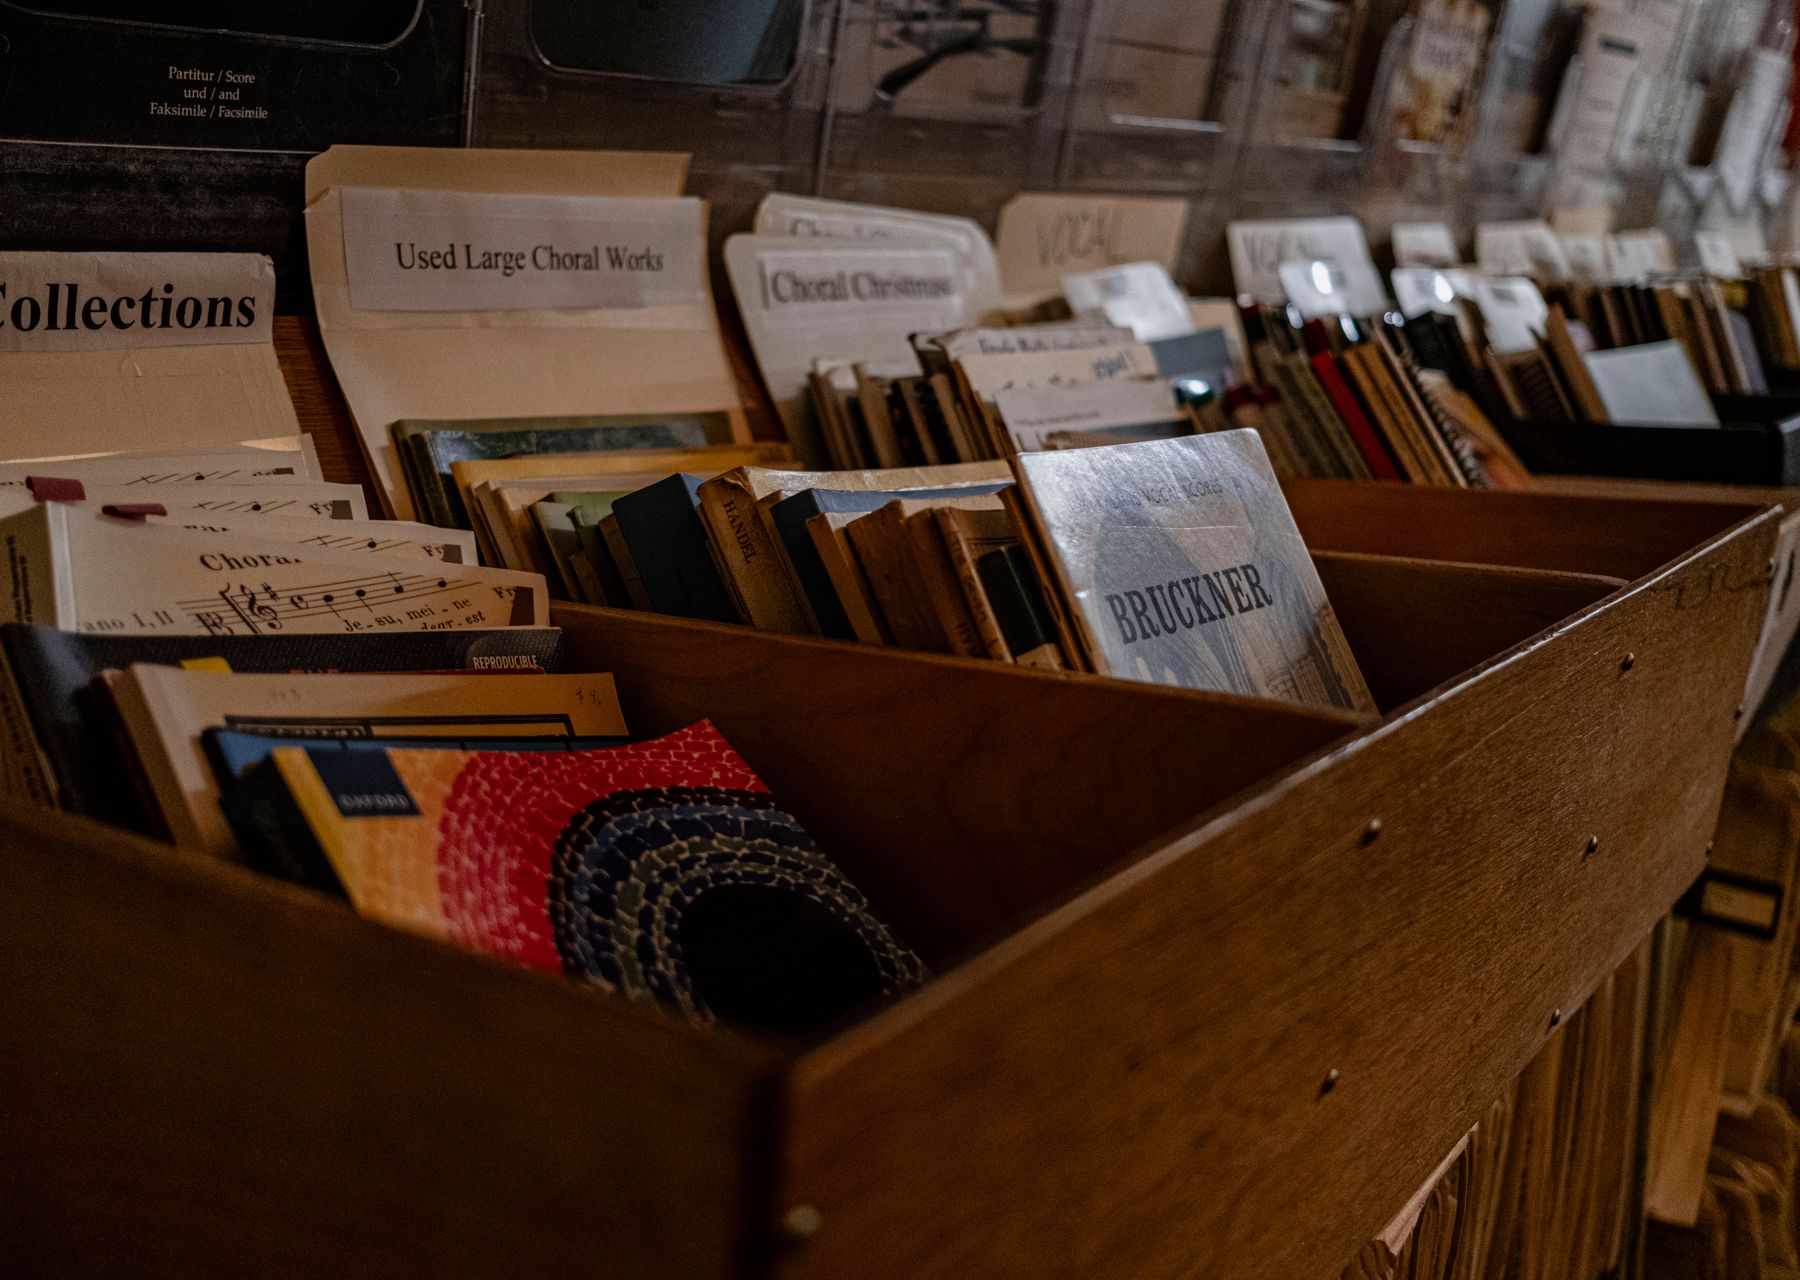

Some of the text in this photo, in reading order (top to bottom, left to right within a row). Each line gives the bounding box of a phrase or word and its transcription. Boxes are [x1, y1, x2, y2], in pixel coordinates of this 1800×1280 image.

[168, 66, 215, 81] Partitur
[225, 70, 256, 84] Score
[184, 87, 207, 99] und
[219, 89, 240, 100] and
[150, 102, 207, 117] Faksimile
[218, 105, 269, 119] Facsimile
[394, 243, 664, 277] Used Large Choral Works
[771, 270, 848, 303] Choral
[723, 500, 757, 564] HANDEL
[200, 553, 302, 571] Chora
[1104, 563, 1274, 645] BRUCKNER
[473, 655, 538, 670] REPRODUCIBLE
